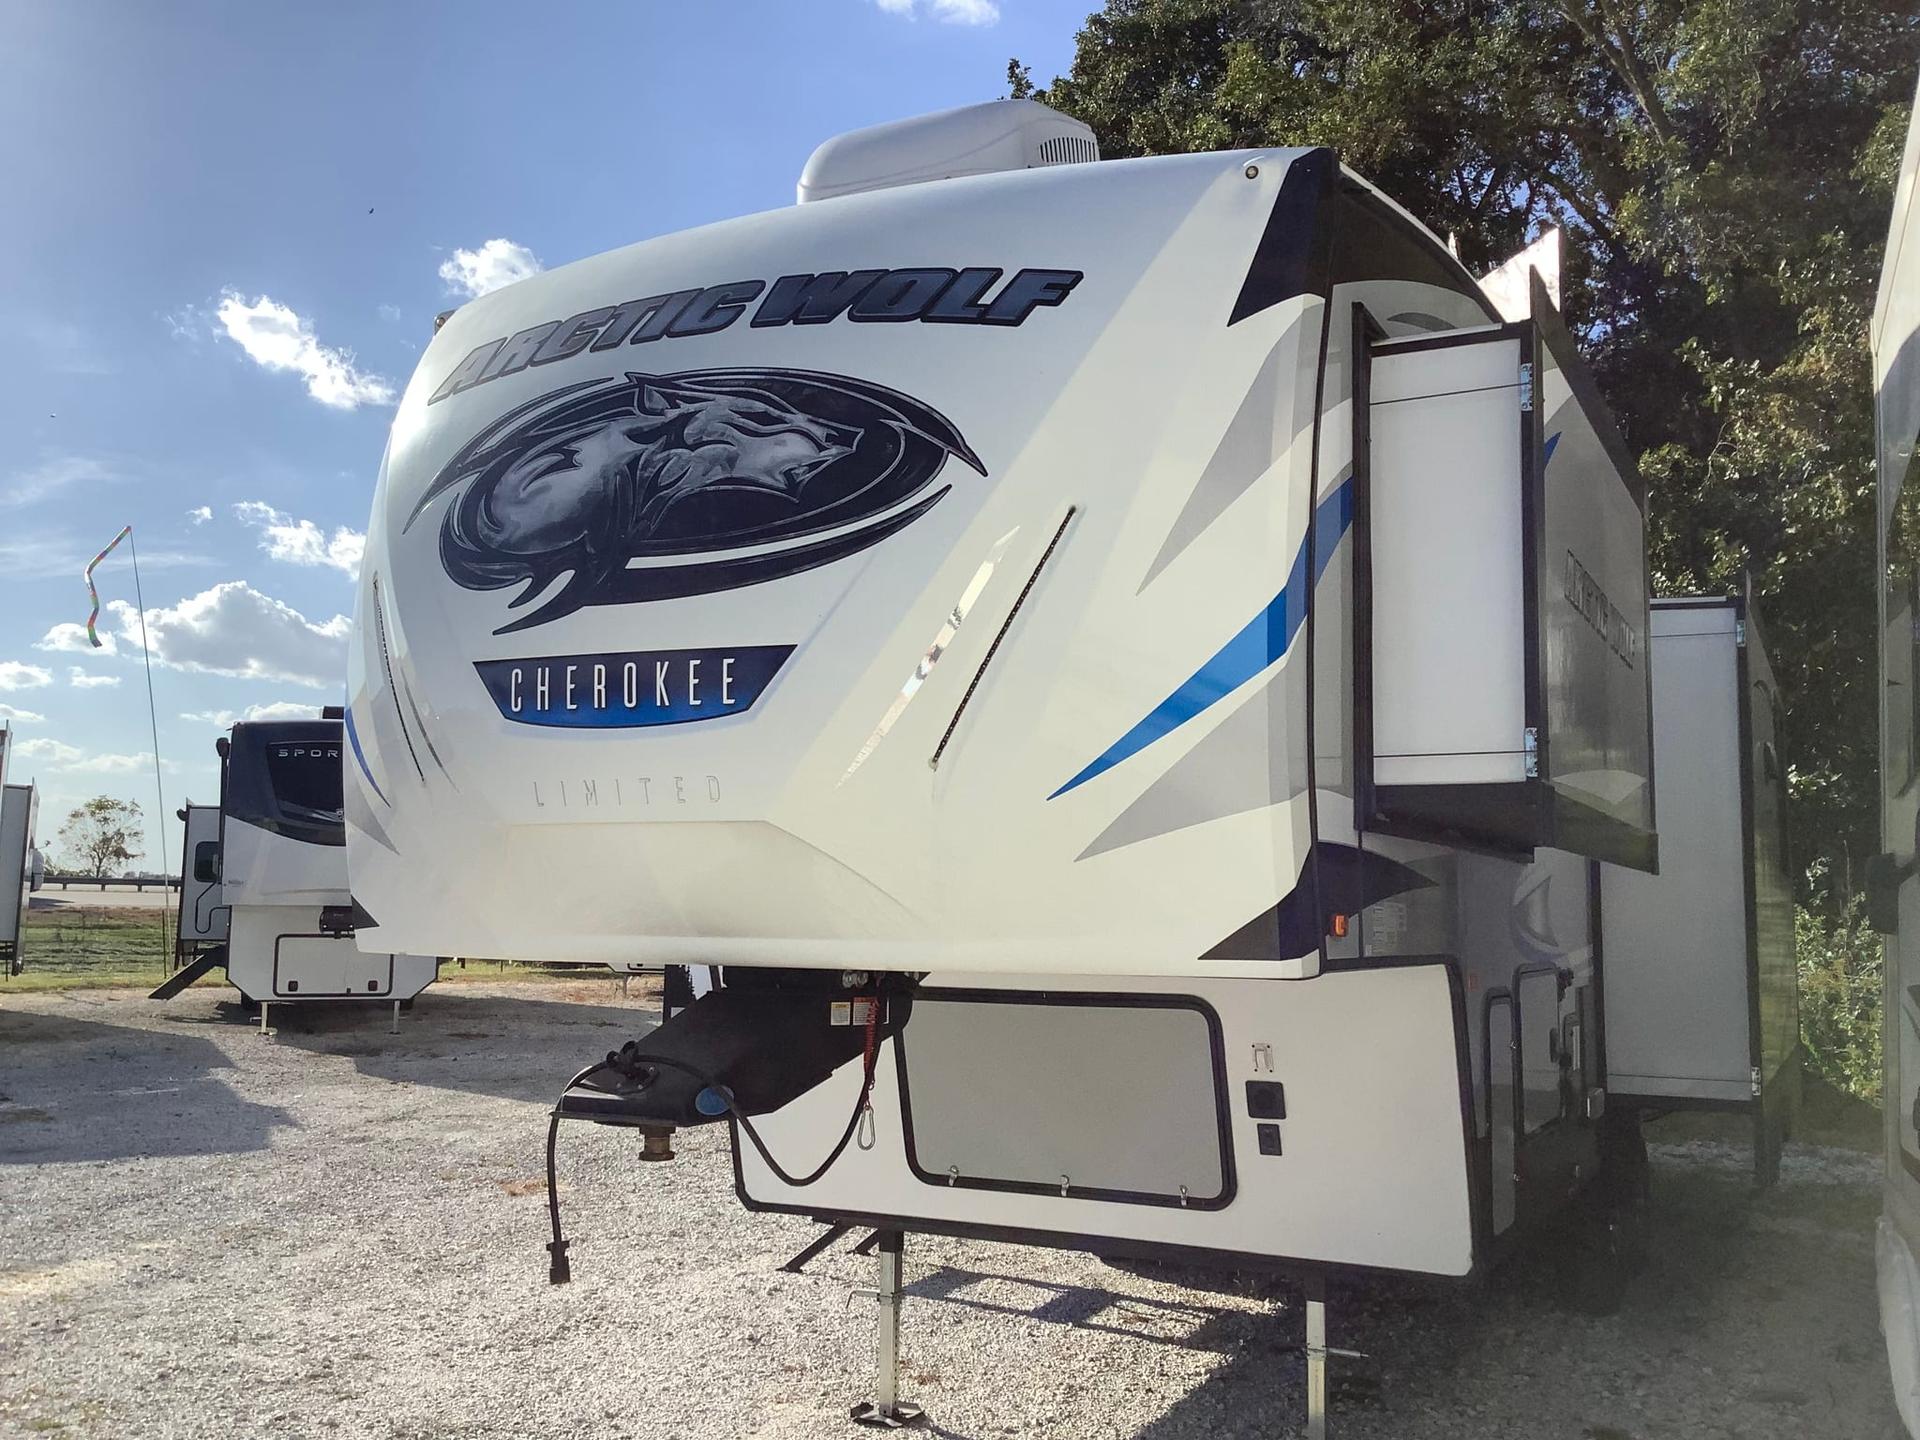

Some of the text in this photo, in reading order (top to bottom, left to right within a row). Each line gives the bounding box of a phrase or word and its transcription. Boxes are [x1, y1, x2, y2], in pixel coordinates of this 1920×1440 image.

[428, 267, 1084, 406] ARCTIC WOLF
[511, 658, 736, 712] CHEROKEE
[278, 749, 339, 758] SPOR
[533, 775, 722, 807] LIMITED
